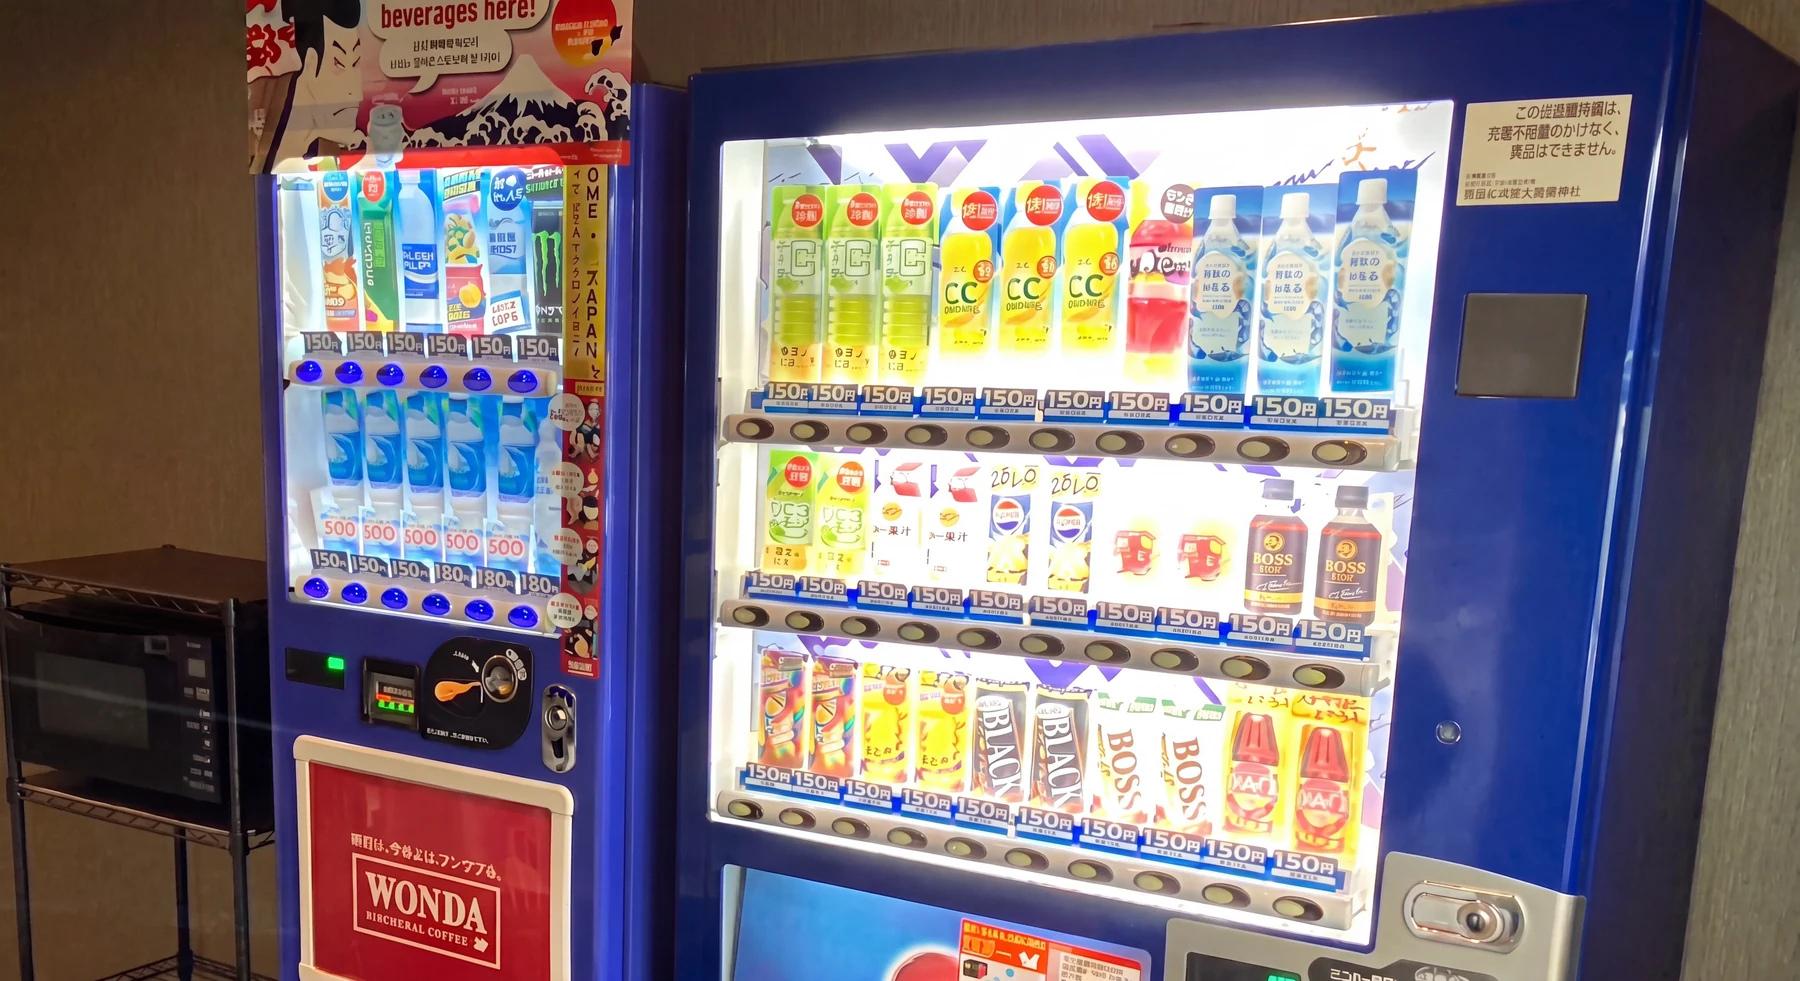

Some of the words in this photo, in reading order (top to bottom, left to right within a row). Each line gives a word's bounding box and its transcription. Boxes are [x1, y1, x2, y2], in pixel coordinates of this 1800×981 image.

[381, 2, 478, 29] beverages
[484, 0, 536, 20] here!
[945, 282, 978, 304] CC
[1007, 277, 1041, 300] CC
[1069, 274, 1103, 298] CC
[769, 383, 808, 400] 150円
[812, 385, 855, 401] 150円
[864, 387, 911, 404] 150円
[925, 388, 974, 405] 150円
[984, 389, 1035, 407] 150円
[1048, 392, 1102, 409] 150円
[1112, 393, 1167, 411] 150円
[1184, 394, 1242, 413] 150円
[1255, 397, 1317, 417] 150円
[1325, 398, 1388, 419] 150円
[325, 521, 355, 537] 500
[364, 525, 395, 541] 500
[405, 529, 437, 545] 500
[446, 534, 479, 551] 500
[489, 538, 523, 557] 500
[1253, 552, 1293, 566] BOSS
[1325, 560, 1366, 574] BOSS
[750, 573, 794, 589] 150円
[801, 577, 845, 594] 150円
[859, 582, 905, 600] 150円
[914, 587, 961, 605] 150円
[970, 590, 1021, 609] 150円
[1032, 597, 1087, 616] 150円
[1098, 602, 1152, 623] 150円
[1159, 608, 1216, 629] 150円
[1230, 615, 1290, 636] 150円
[1299, 620, 1361, 642] 150円
[982, 708, 1023, 798] BLACK
[1043, 718, 1083, 808] BLACK
[748, 764, 790, 783] 150円
[1107, 728, 1141, 810] BOSS
[1172, 737, 1206, 820] BOSS
[795, 771, 839, 791] 150円
[846, 779, 891, 800] 150円
[903, 790, 950, 810] 150円
[959, 797, 1008, 820] 150円
[1020, 808, 1072, 830] 150円
[1083, 819, 1136, 842] 150円
[1145, 829, 1200, 853] 150円
[1207, 839, 1265, 863] 150円
[1275, 851, 1334, 875] 150円
[365, 871, 487, 934] WONDA
[428, 927, 468, 946] COFFEE
